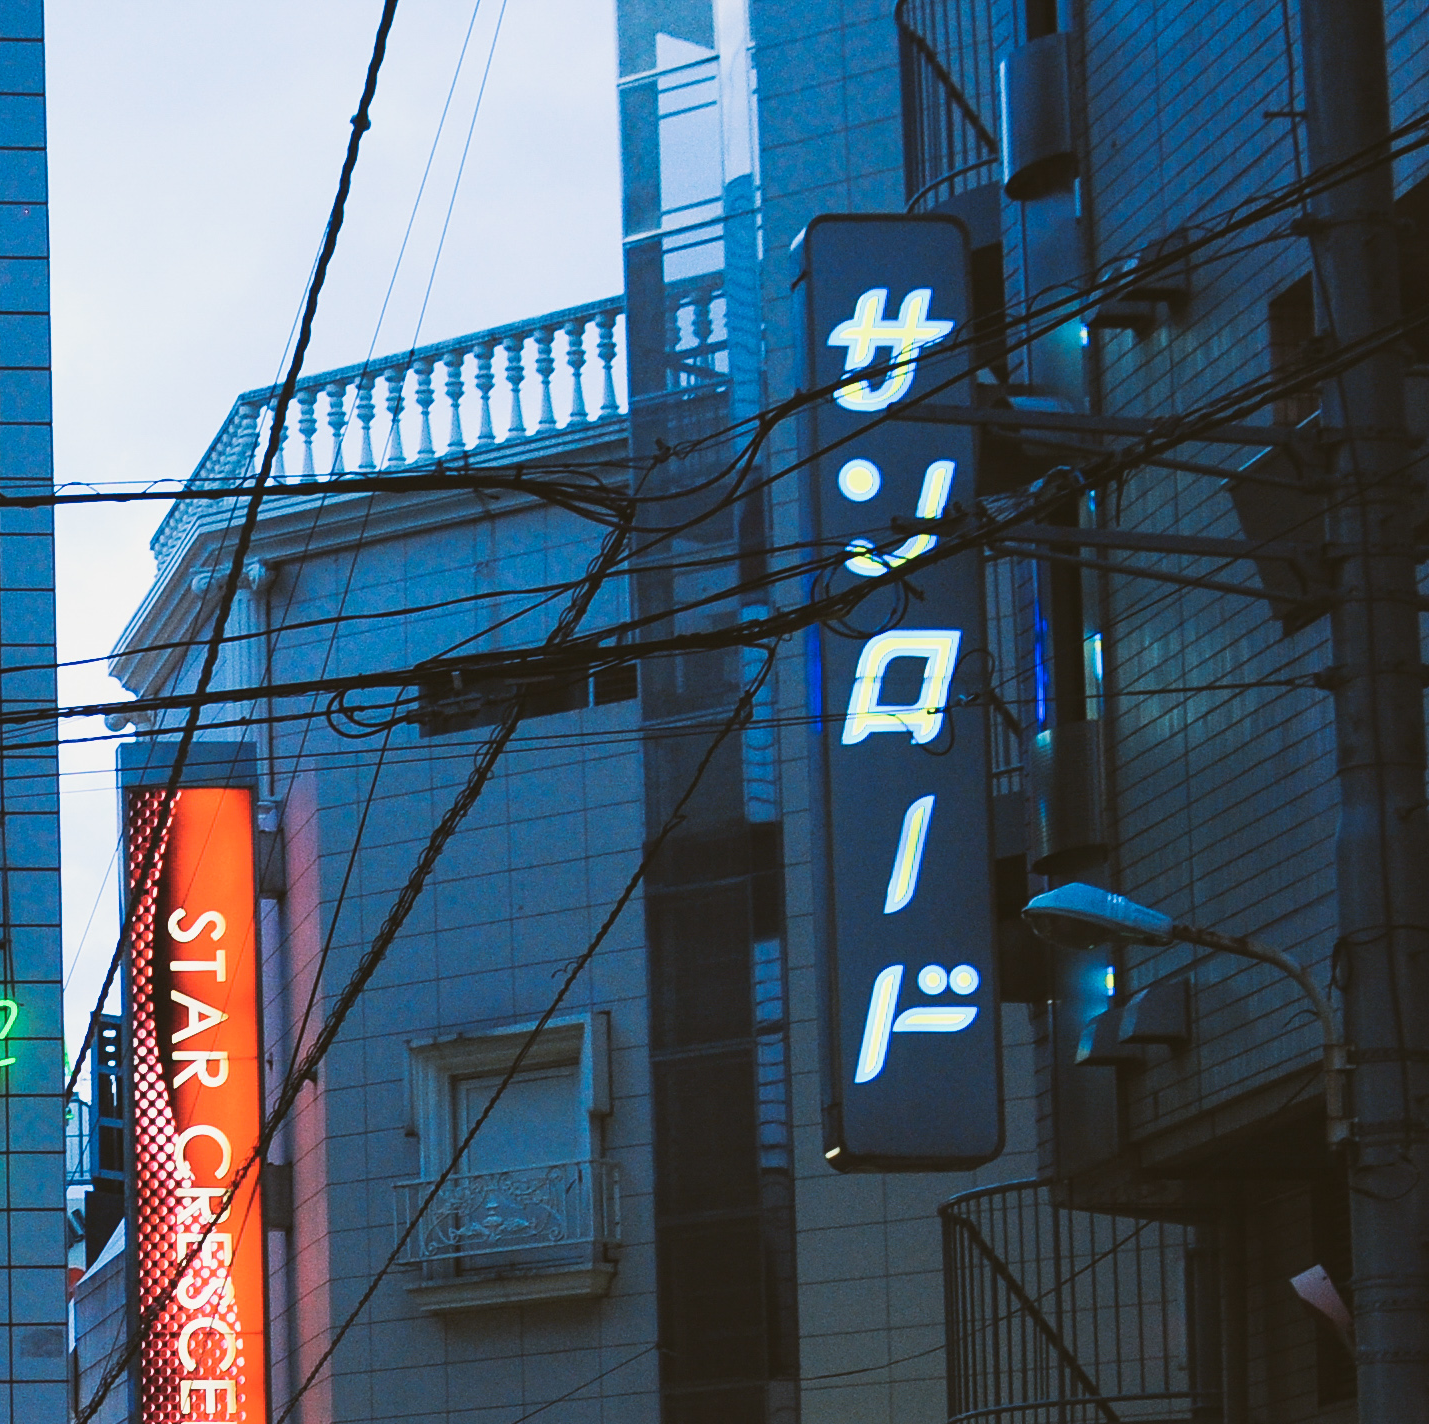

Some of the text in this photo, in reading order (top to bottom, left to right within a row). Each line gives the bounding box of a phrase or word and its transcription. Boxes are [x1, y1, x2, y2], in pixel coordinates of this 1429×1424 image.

[827, 286, 979, 1086] サンロード
[166, 906, 231, 1091] STAR
